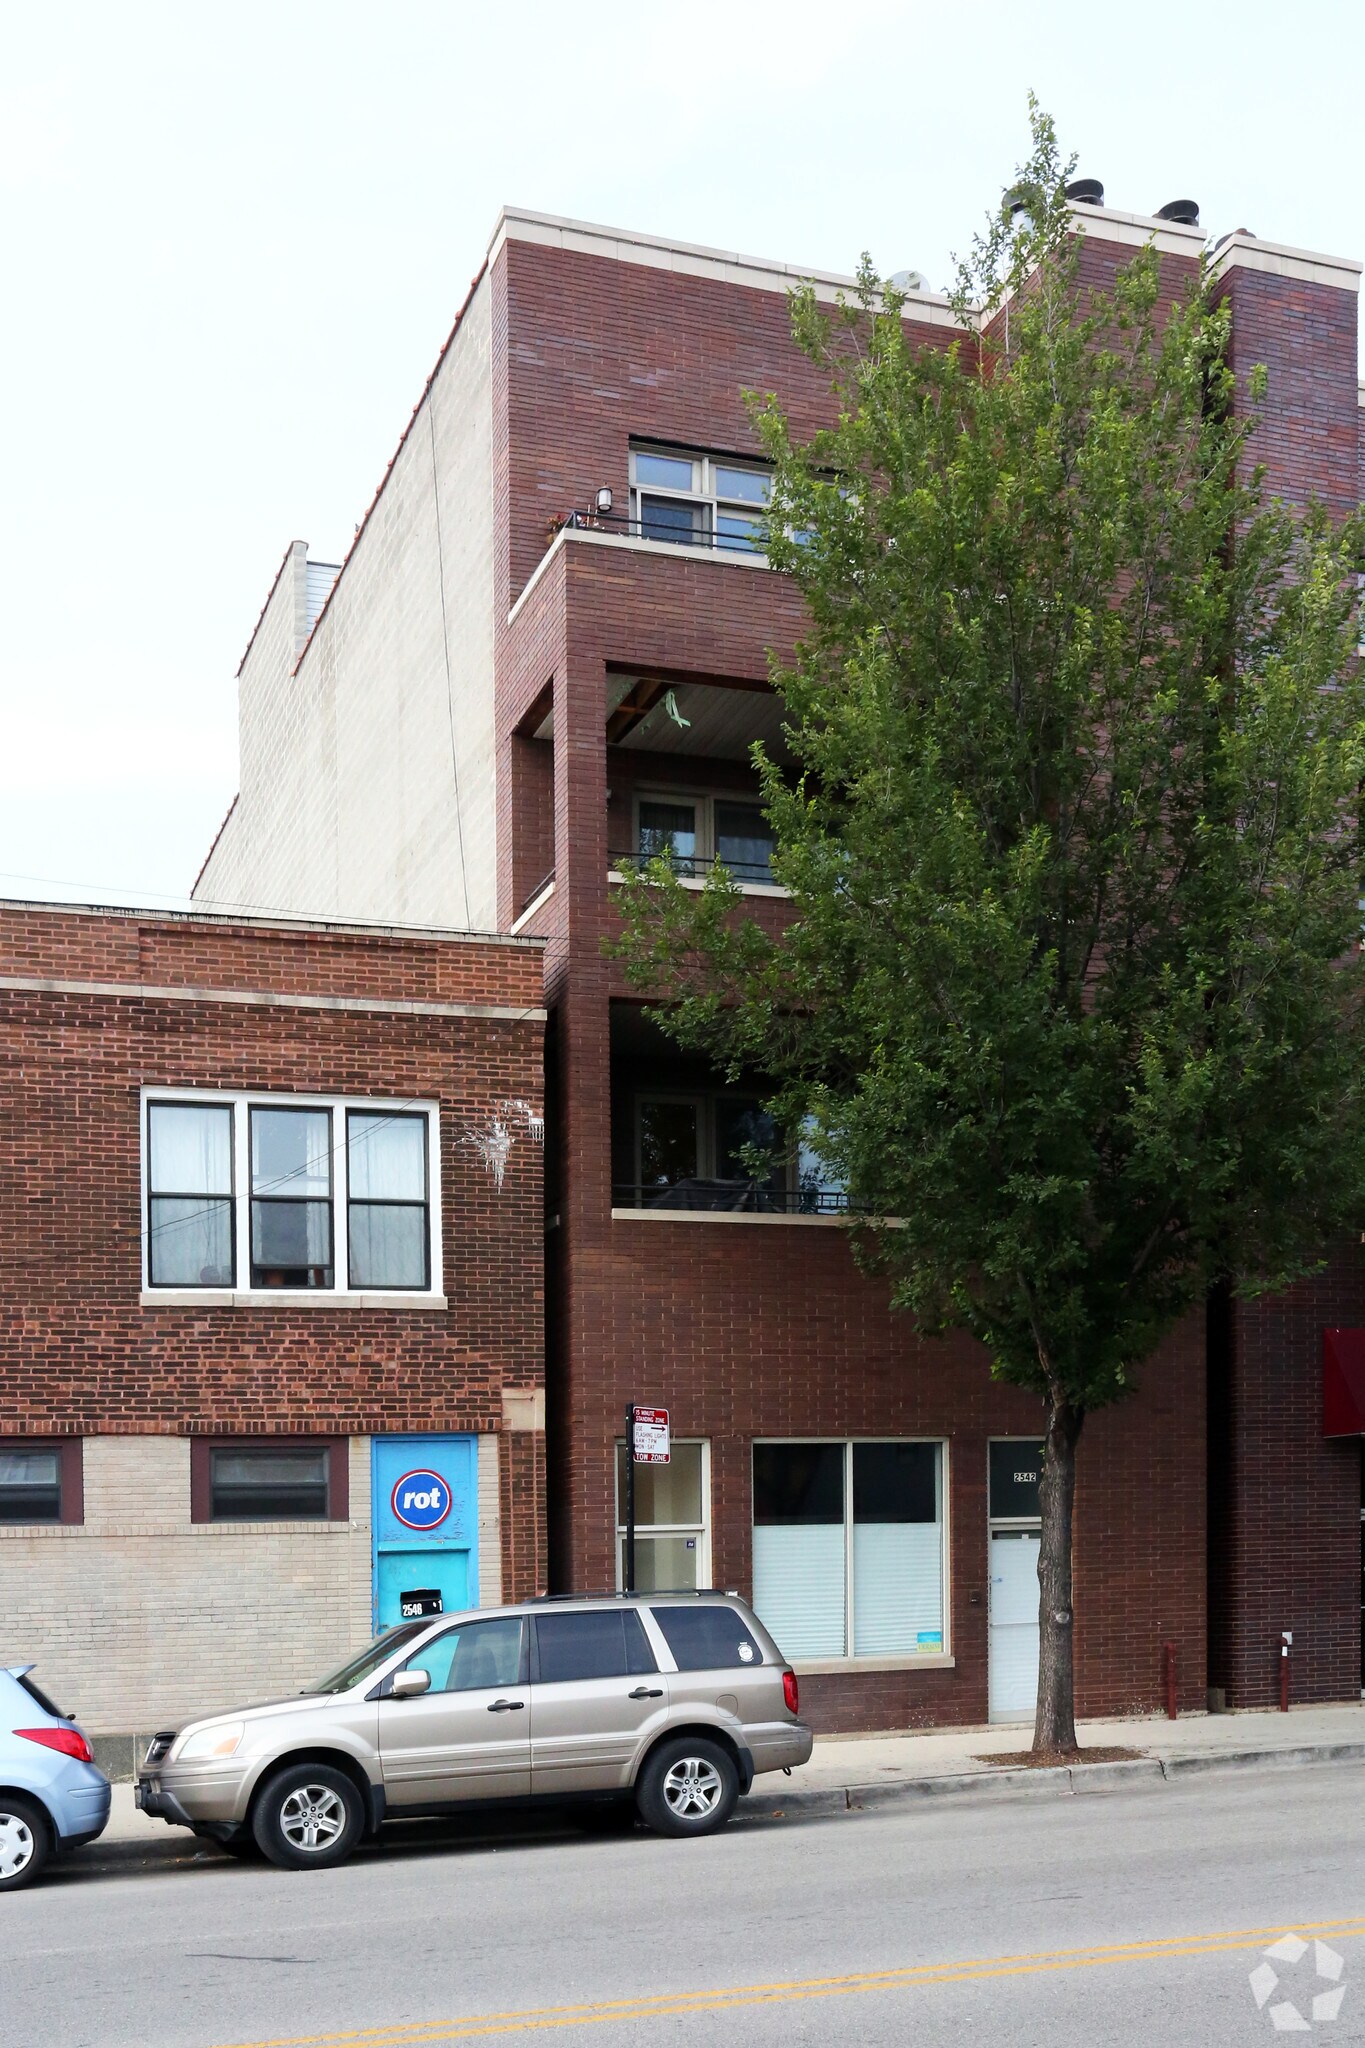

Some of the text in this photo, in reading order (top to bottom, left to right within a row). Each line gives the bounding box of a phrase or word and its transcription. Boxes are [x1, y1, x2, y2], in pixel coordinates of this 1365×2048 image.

[636, 1453, 667, 1462] TOW ZONE
[1014, 1473, 1036, 1482] 2542
[403, 1487, 441, 1510] rot
[402, 1603, 423, 1617] 2548
